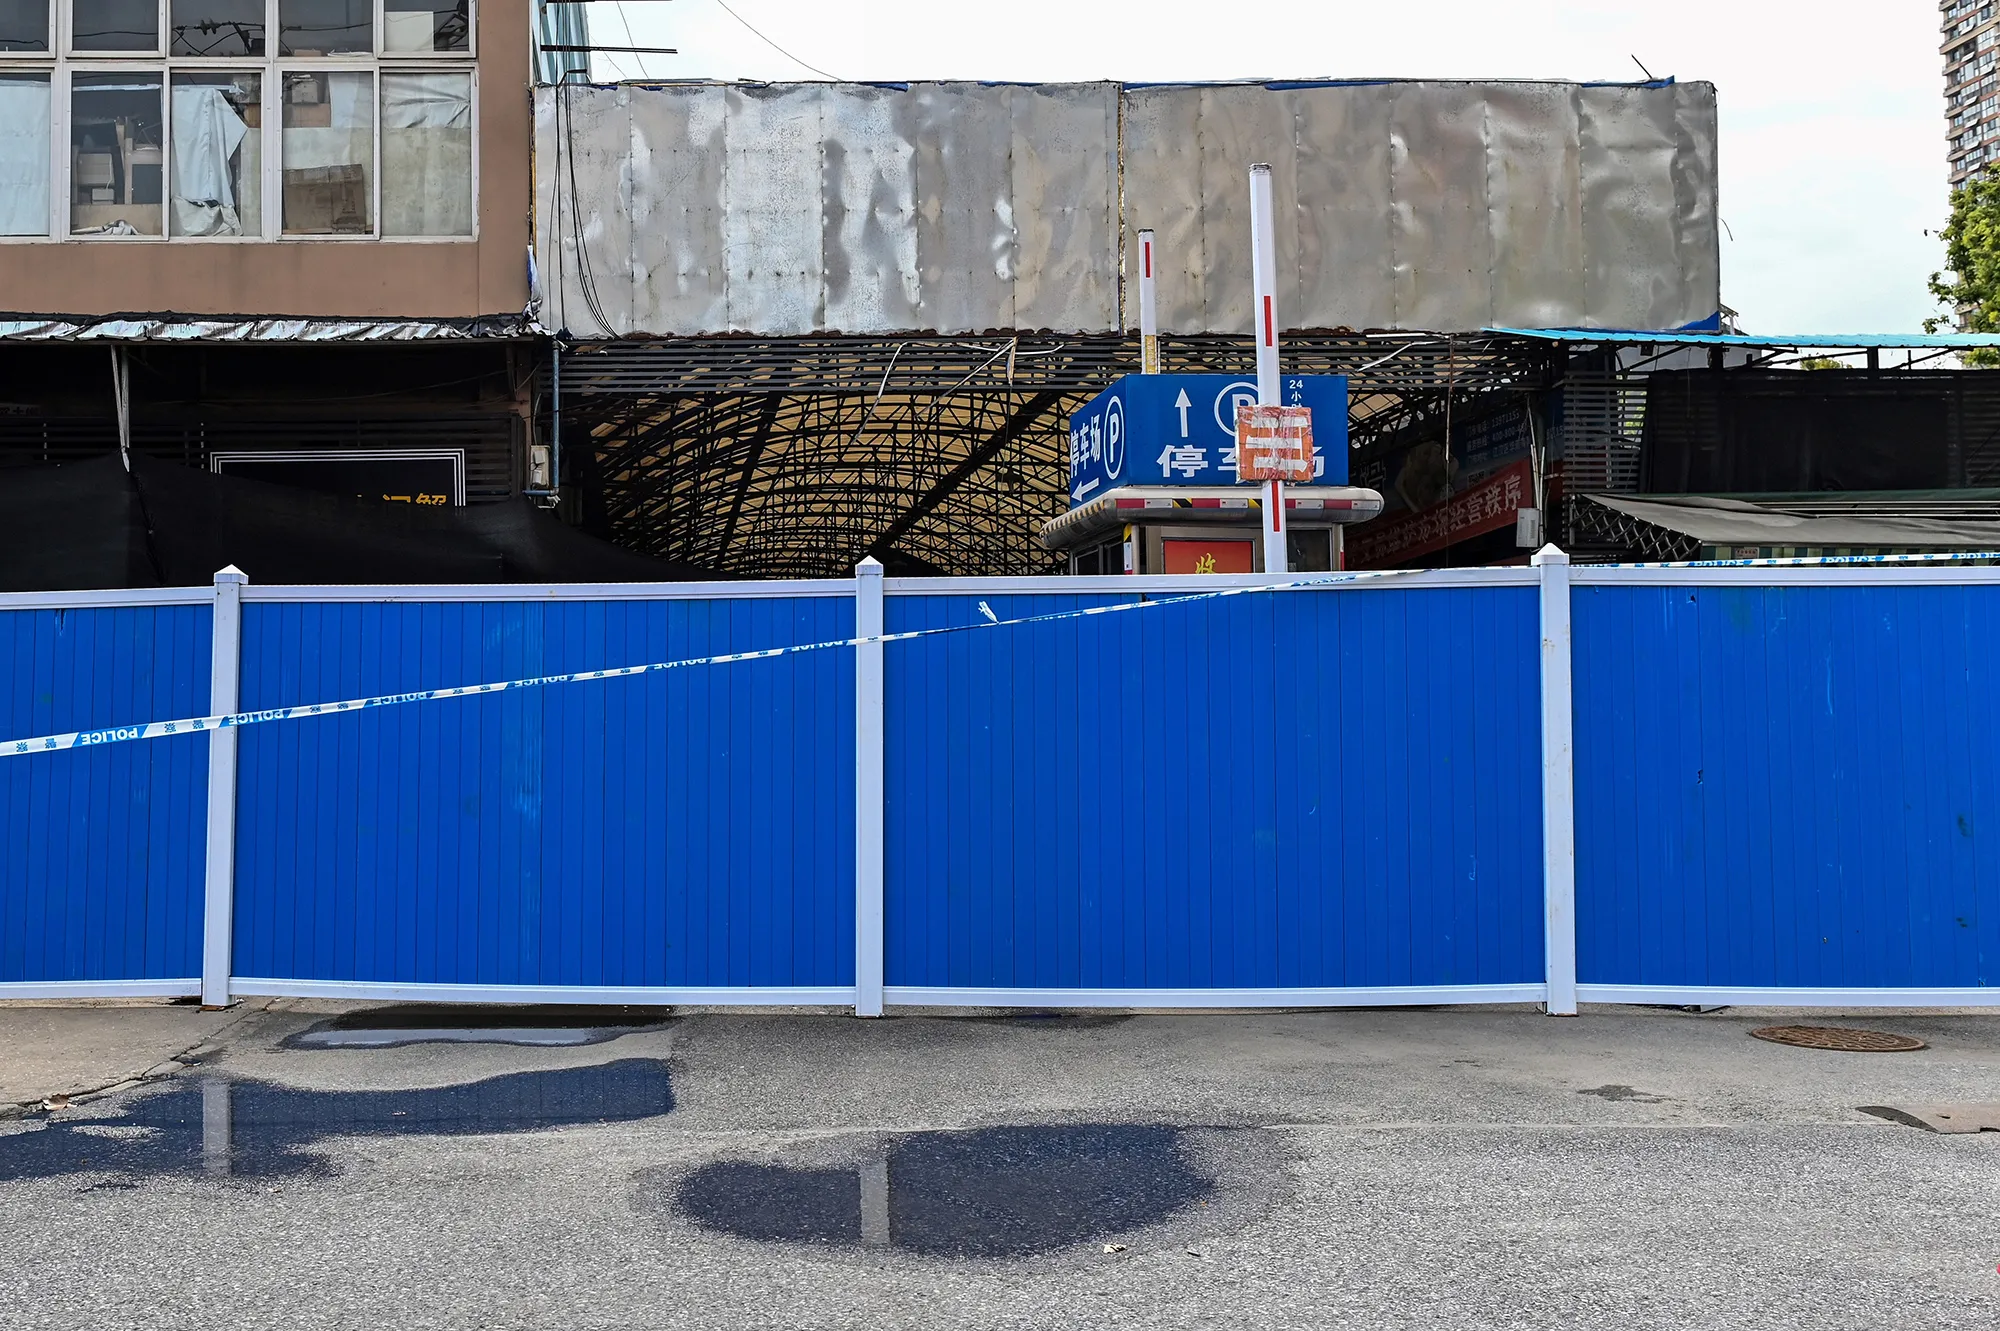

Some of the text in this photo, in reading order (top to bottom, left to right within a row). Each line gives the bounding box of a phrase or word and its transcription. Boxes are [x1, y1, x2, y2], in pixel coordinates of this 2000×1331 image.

[1070, 413, 1101, 479] 停车场
[1109, 413, 1120, 464] P
[228, 709, 284, 726] POLICE
[81, 727, 139, 746] POLICE
